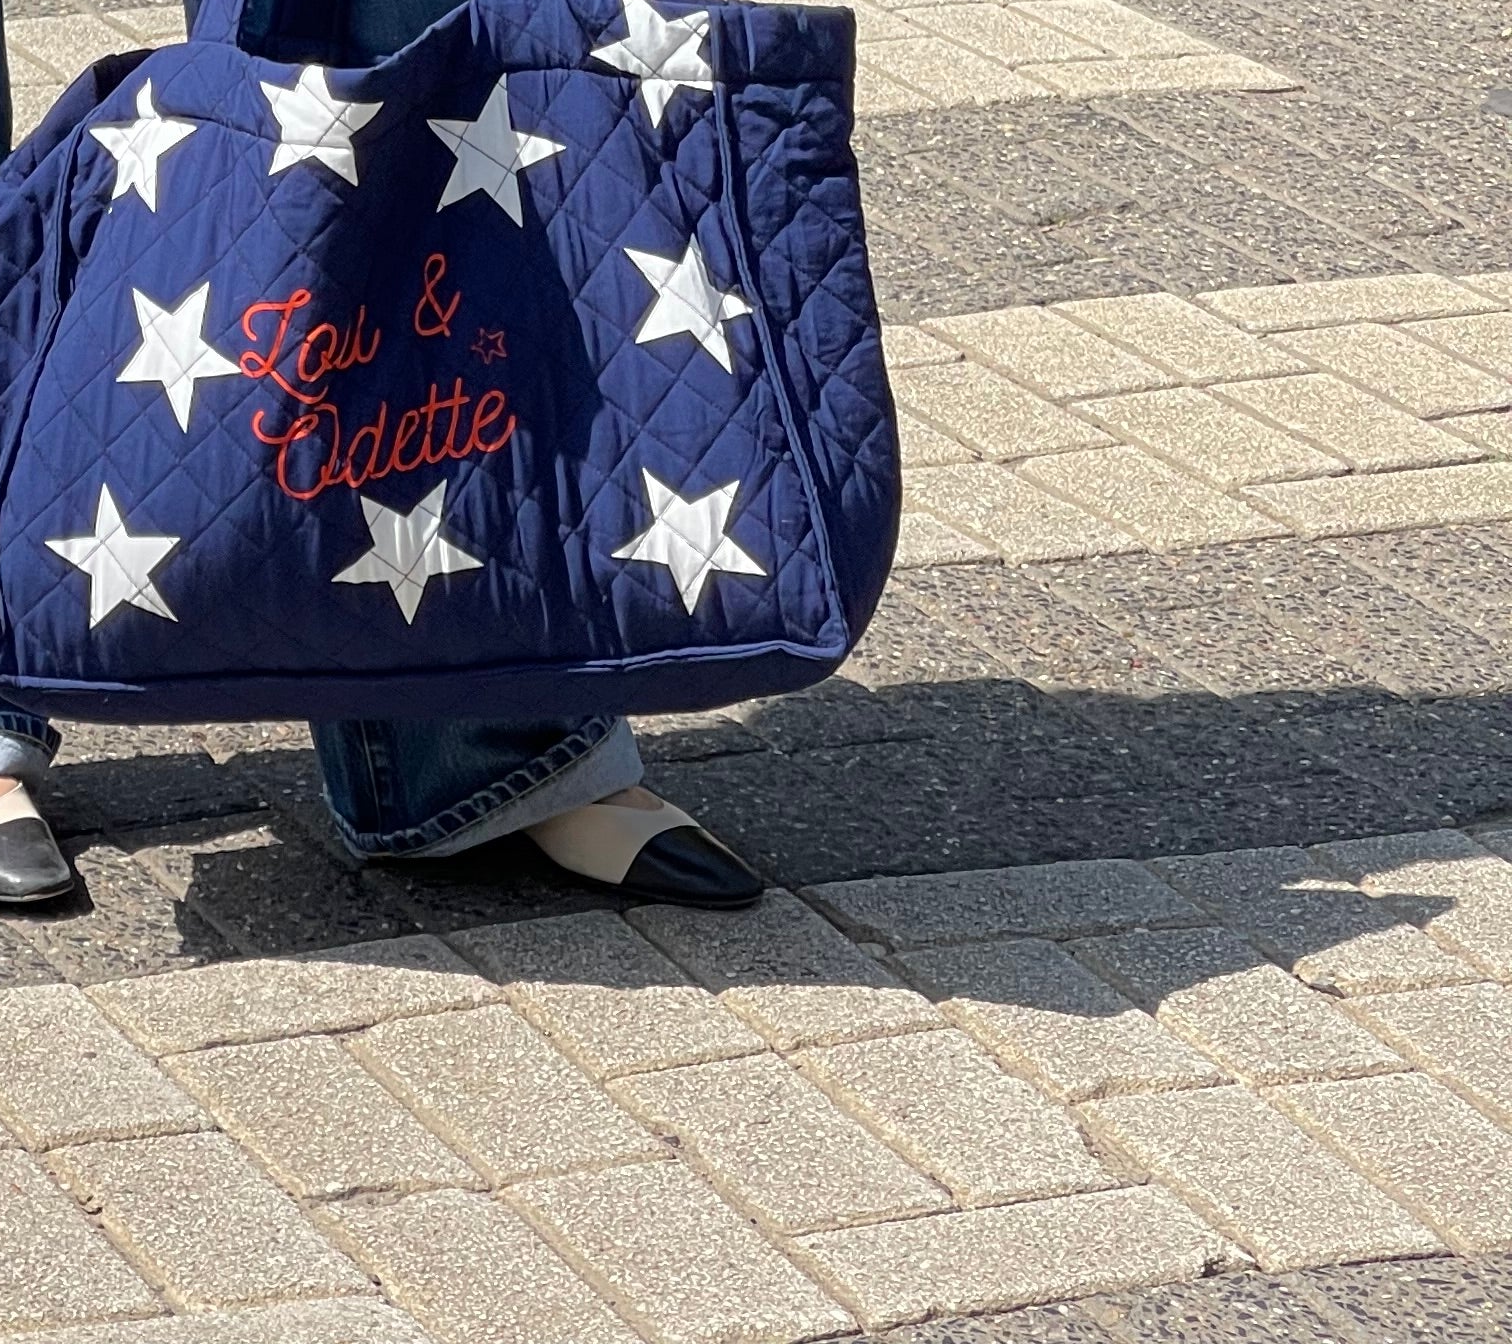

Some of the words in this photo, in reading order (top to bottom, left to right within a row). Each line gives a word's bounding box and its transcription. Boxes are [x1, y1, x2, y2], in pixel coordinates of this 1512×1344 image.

[238, 287, 382, 405] Lou
[414, 252, 462, 338] &
[251, 377, 516, 502] Odette
